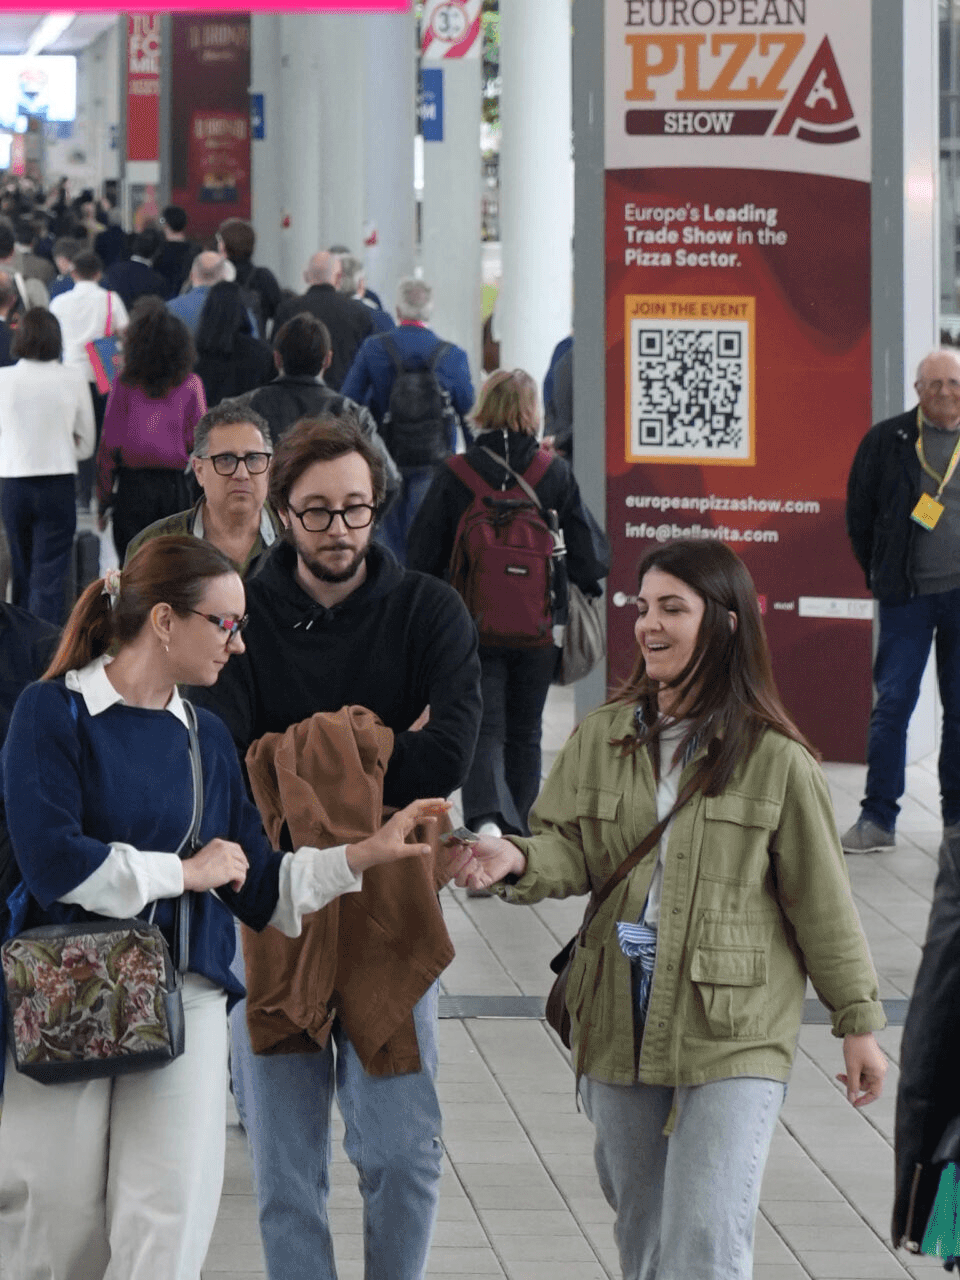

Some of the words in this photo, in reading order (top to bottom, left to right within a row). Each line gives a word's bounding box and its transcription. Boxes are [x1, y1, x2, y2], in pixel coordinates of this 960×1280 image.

[664, 111, 735, 134] SHOW
[624, 203, 701, 225] Europe's
[704, 204, 778, 227] Leading
[624, 226, 679, 245] Trade
[682, 227, 733, 245] Show
[737, 228, 754, 245] in
[757, 228, 788, 246] the
[624, 249, 672, 267] Pizza
[675, 249, 742, 268] Sector.
[631, 302, 667, 316] JOIN
[669, 302, 697, 316] THE
[700, 303, 749, 317] EVENT
[624, 494, 821, 514] europeanpizzashow.com
